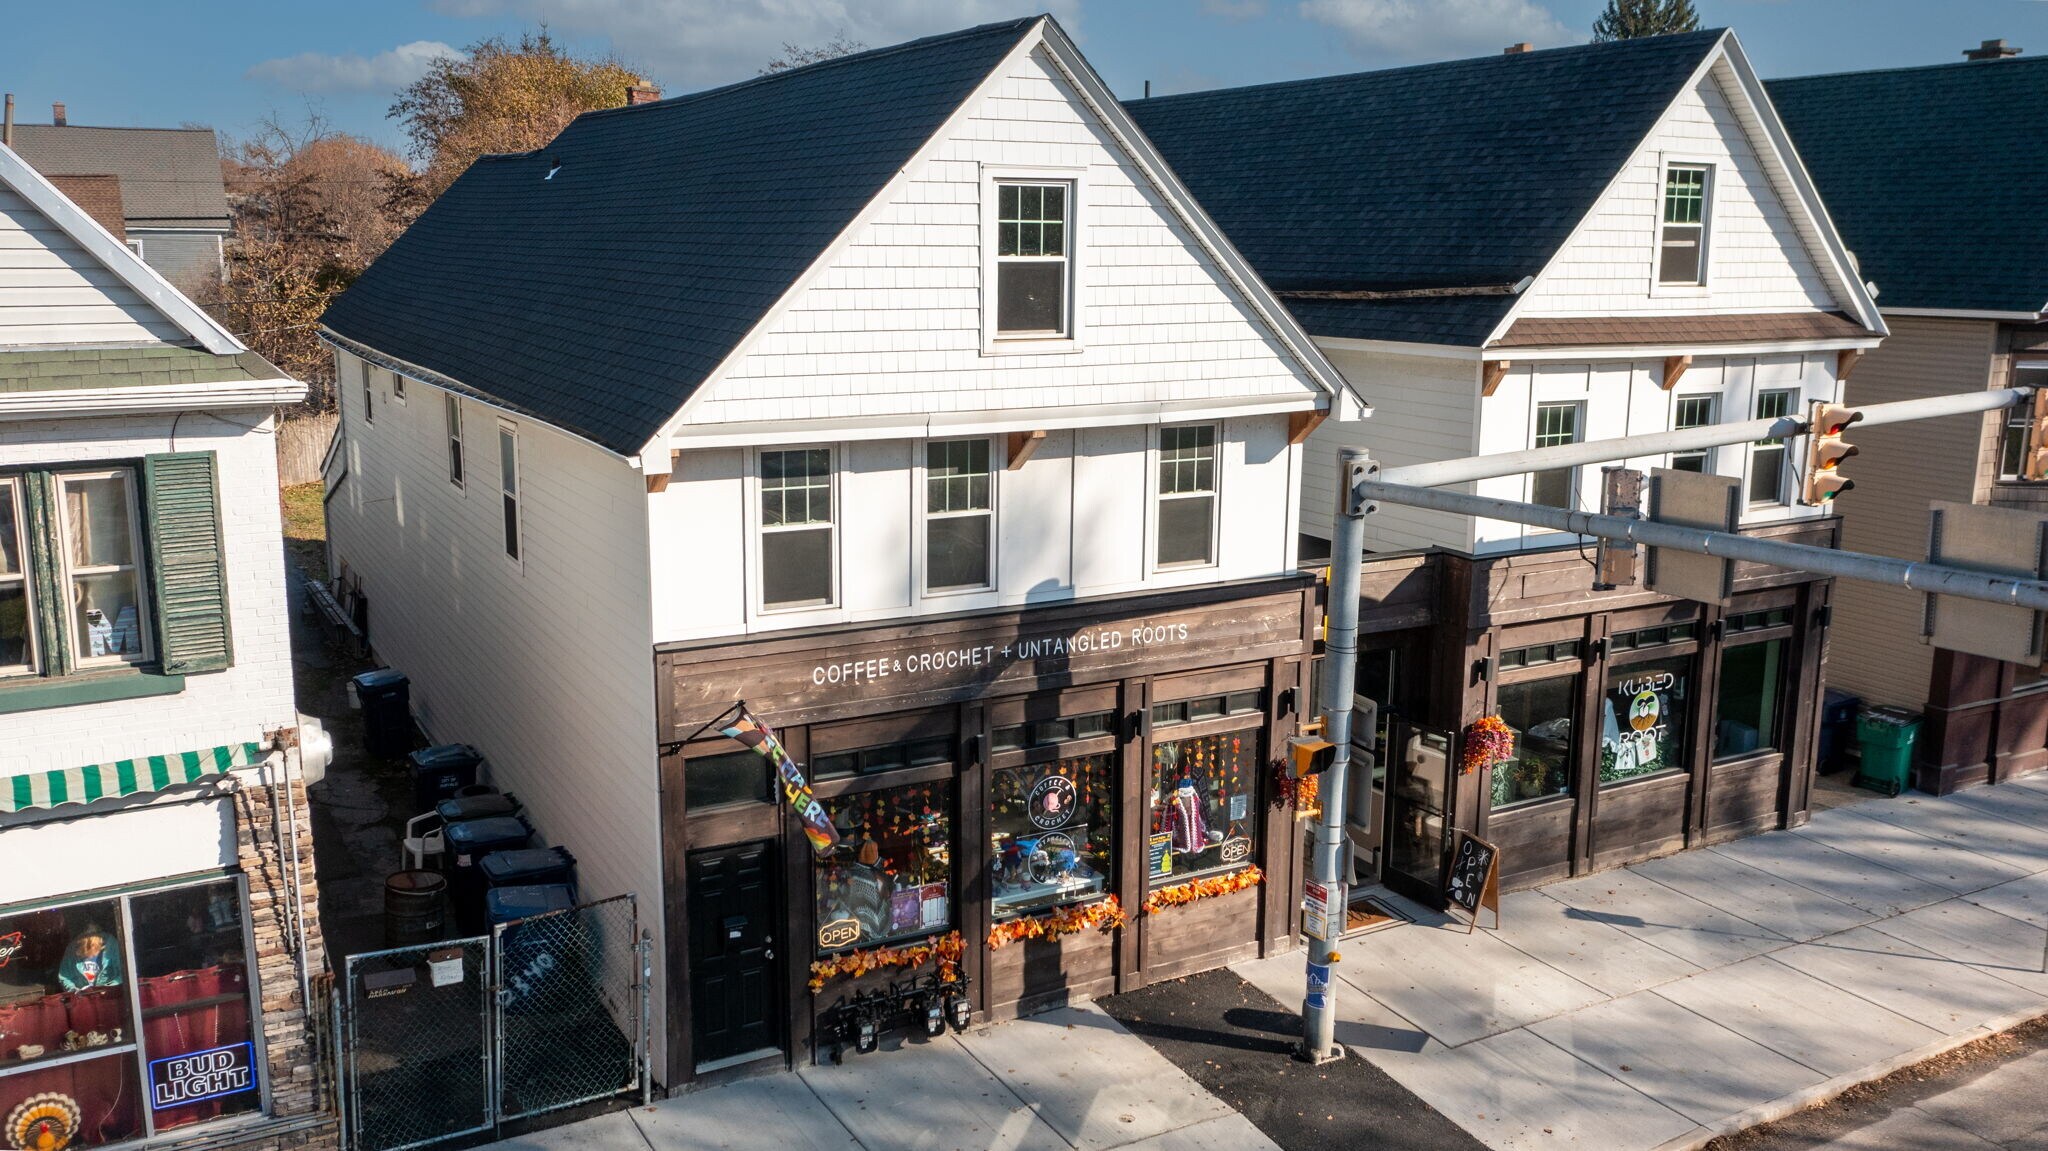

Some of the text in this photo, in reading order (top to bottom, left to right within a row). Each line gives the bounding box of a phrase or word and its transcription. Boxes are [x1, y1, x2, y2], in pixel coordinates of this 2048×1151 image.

[812, 657, 890, 685] COFFEE
[892, 659, 902, 672] &
[906, 645, 994, 673] CROCHET
[1017, 631, 1122, 660] UNTANGLED
[1131, 623, 1188, 646] ROOTS
[1618, 672, 1674, 697] KUBED
[1619, 724, 1667, 749] ROOT
[1034, 779, 1064, 796] COFFEE
[785, 783, 829, 828] HERE
[1034, 809, 1070, 826] CROCHET
[1223, 844, 1249, 858] OPEN
[1463, 840, 1477, 907] OPEN
[821, 925, 858, 944] OPEN
[168, 1050, 235, 1082] BUD
[155, 1067, 249, 1104] LIGHT
